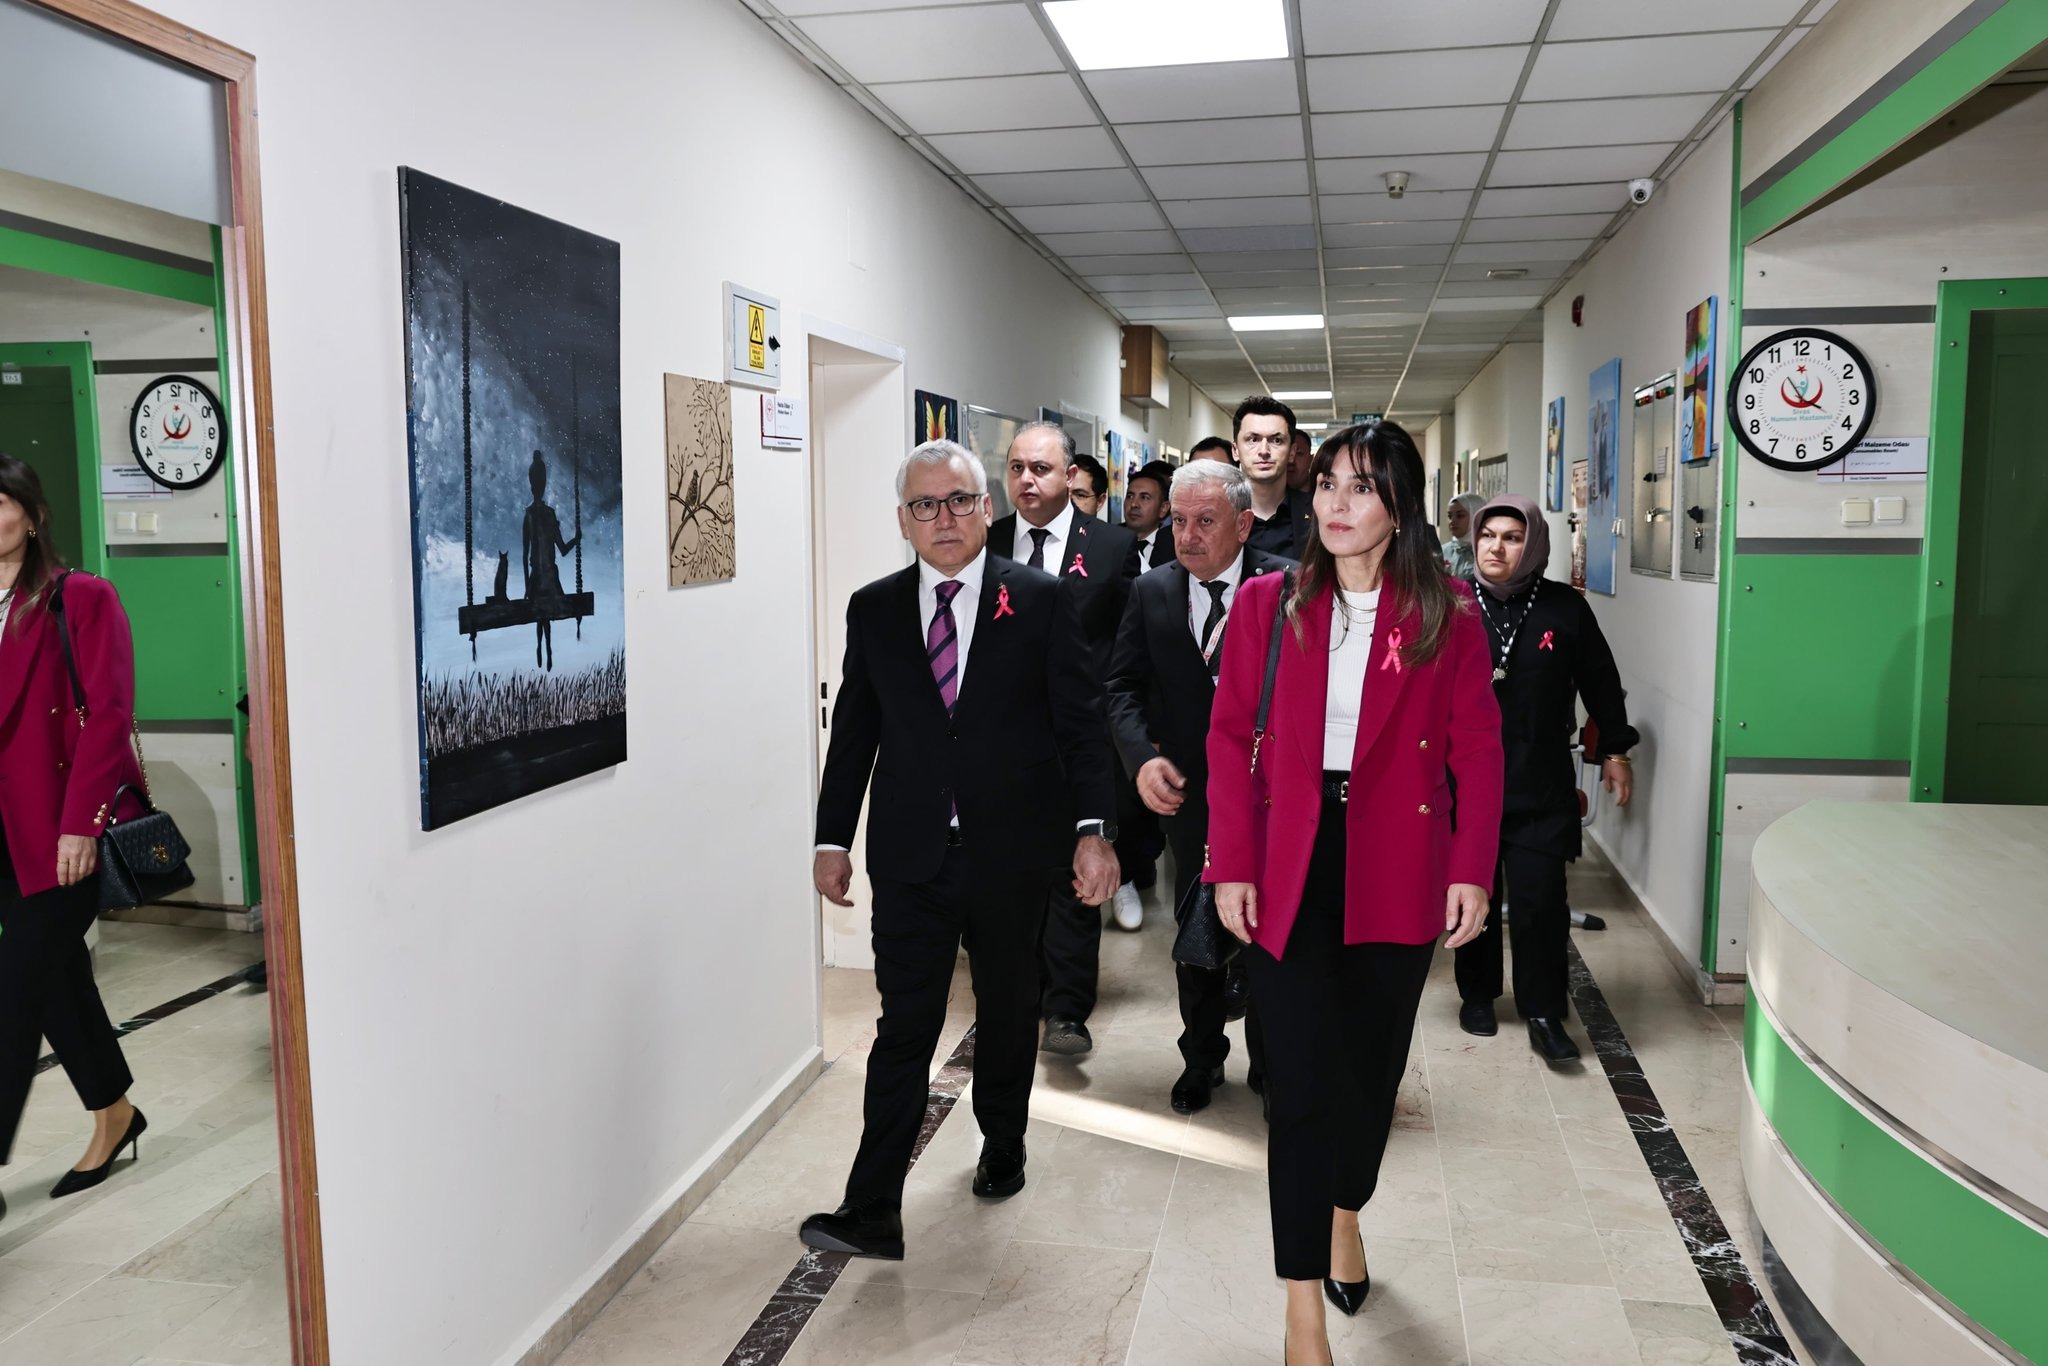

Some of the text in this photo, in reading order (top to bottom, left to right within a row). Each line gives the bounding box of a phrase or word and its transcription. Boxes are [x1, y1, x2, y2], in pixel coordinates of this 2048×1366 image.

[1768, 347, 1781, 363] 11
[1793, 340, 1810, 356] 12
[1824, 345, 1830, 360] 1
[1748, 368, 1764, 383] 10
[1843, 364, 1854, 379] 2
[1745, 394, 1755, 410] 9
[1849, 390, 1859, 405] 3
[1750, 419, 1760, 434] 8
[1841, 415, 1852, 431] 4
[1768, 439, 1779, 454] 7
[1823, 436, 1833, 451] 5
[1796, 444, 1806, 459] 6
